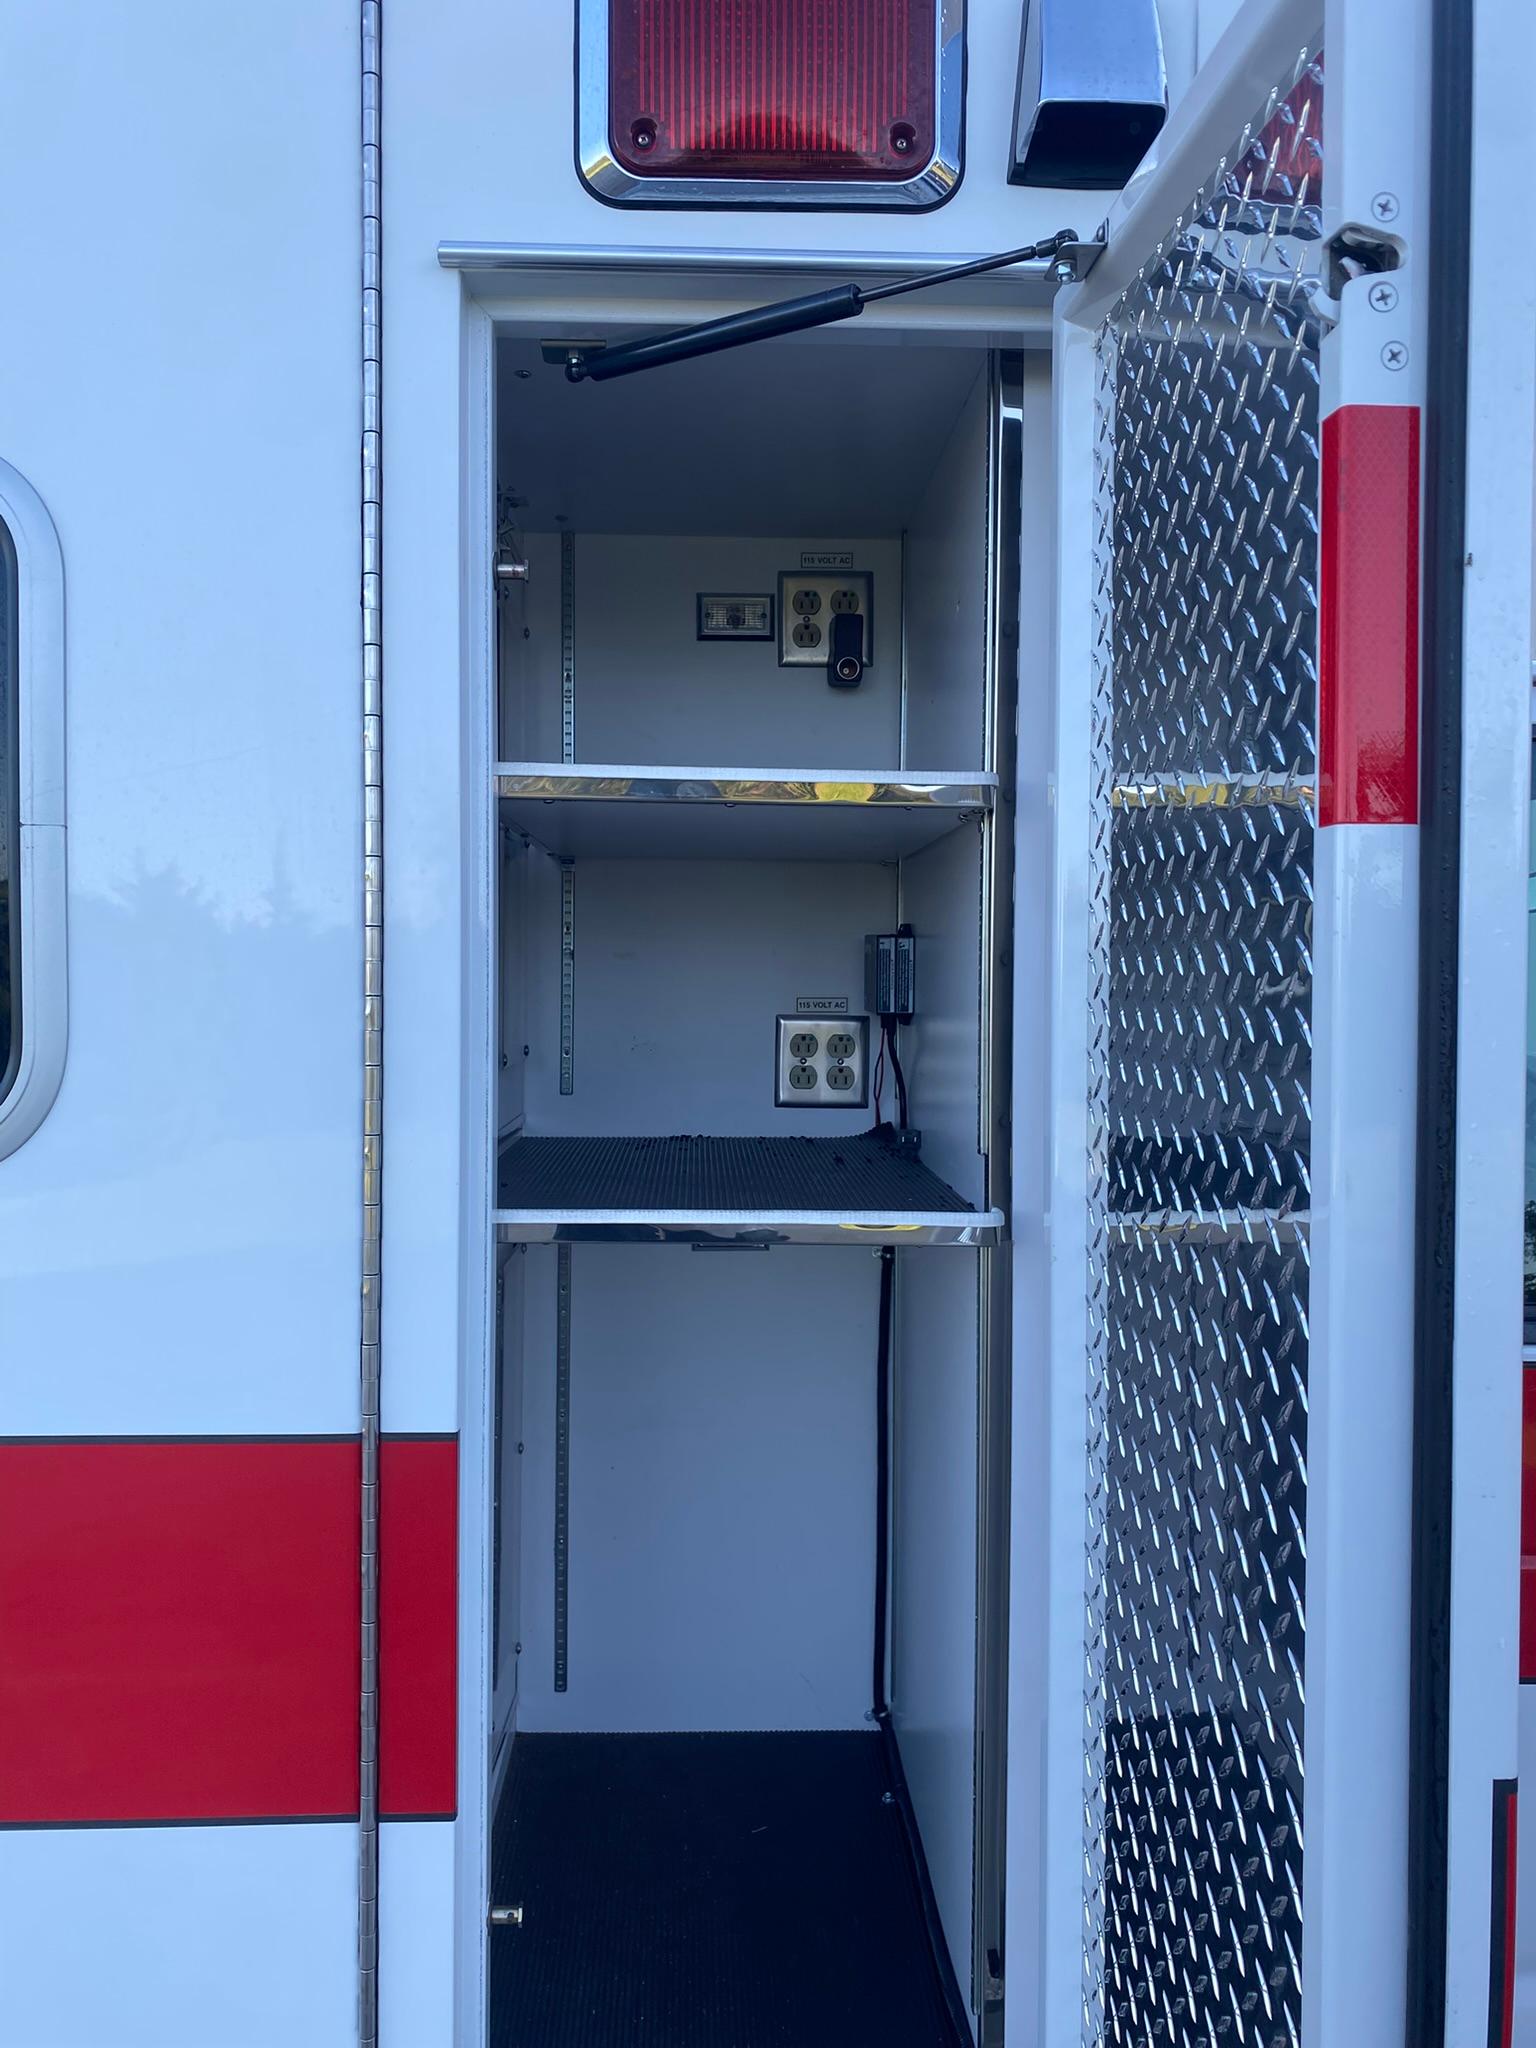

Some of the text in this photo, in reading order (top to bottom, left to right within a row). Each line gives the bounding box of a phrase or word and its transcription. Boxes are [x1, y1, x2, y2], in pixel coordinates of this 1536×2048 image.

[803, 556, 851, 564] 115 VOLT AC
[799, 1001, 846, 1009] 115 VOLT AC
